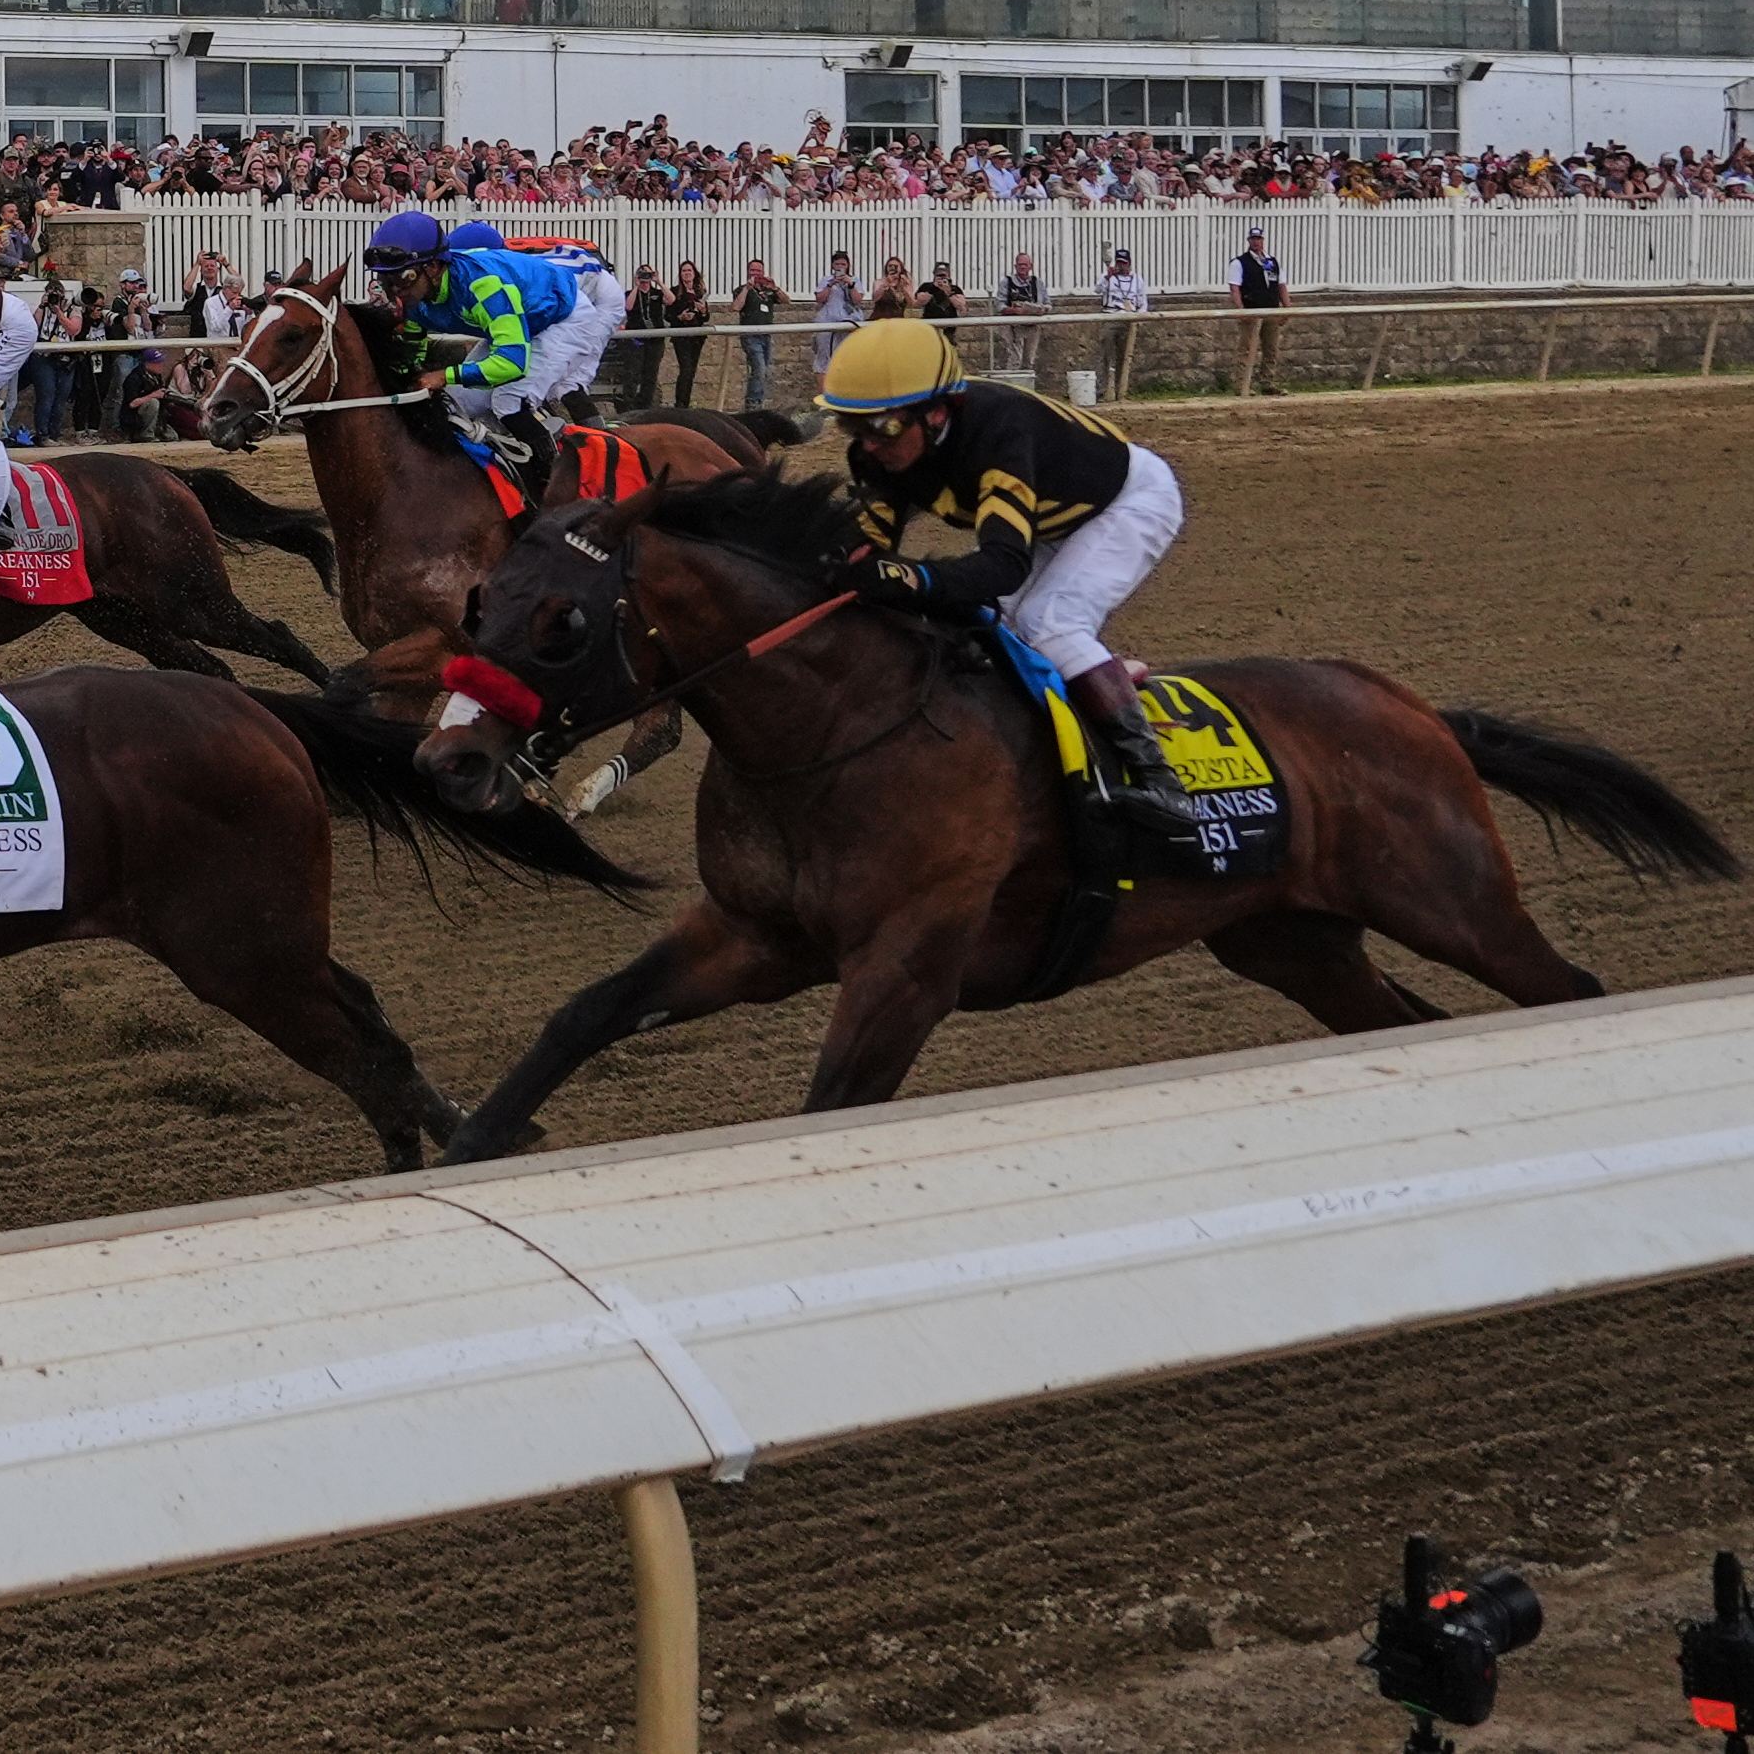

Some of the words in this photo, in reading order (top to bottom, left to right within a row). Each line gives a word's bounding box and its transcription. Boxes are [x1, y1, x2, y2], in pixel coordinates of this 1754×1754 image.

[11, 465, 71, 529] 11
[49, 533, 72, 549] ORO
[21, 572, 40, 588] 151
[1198, 822, 1239, 853] 151
